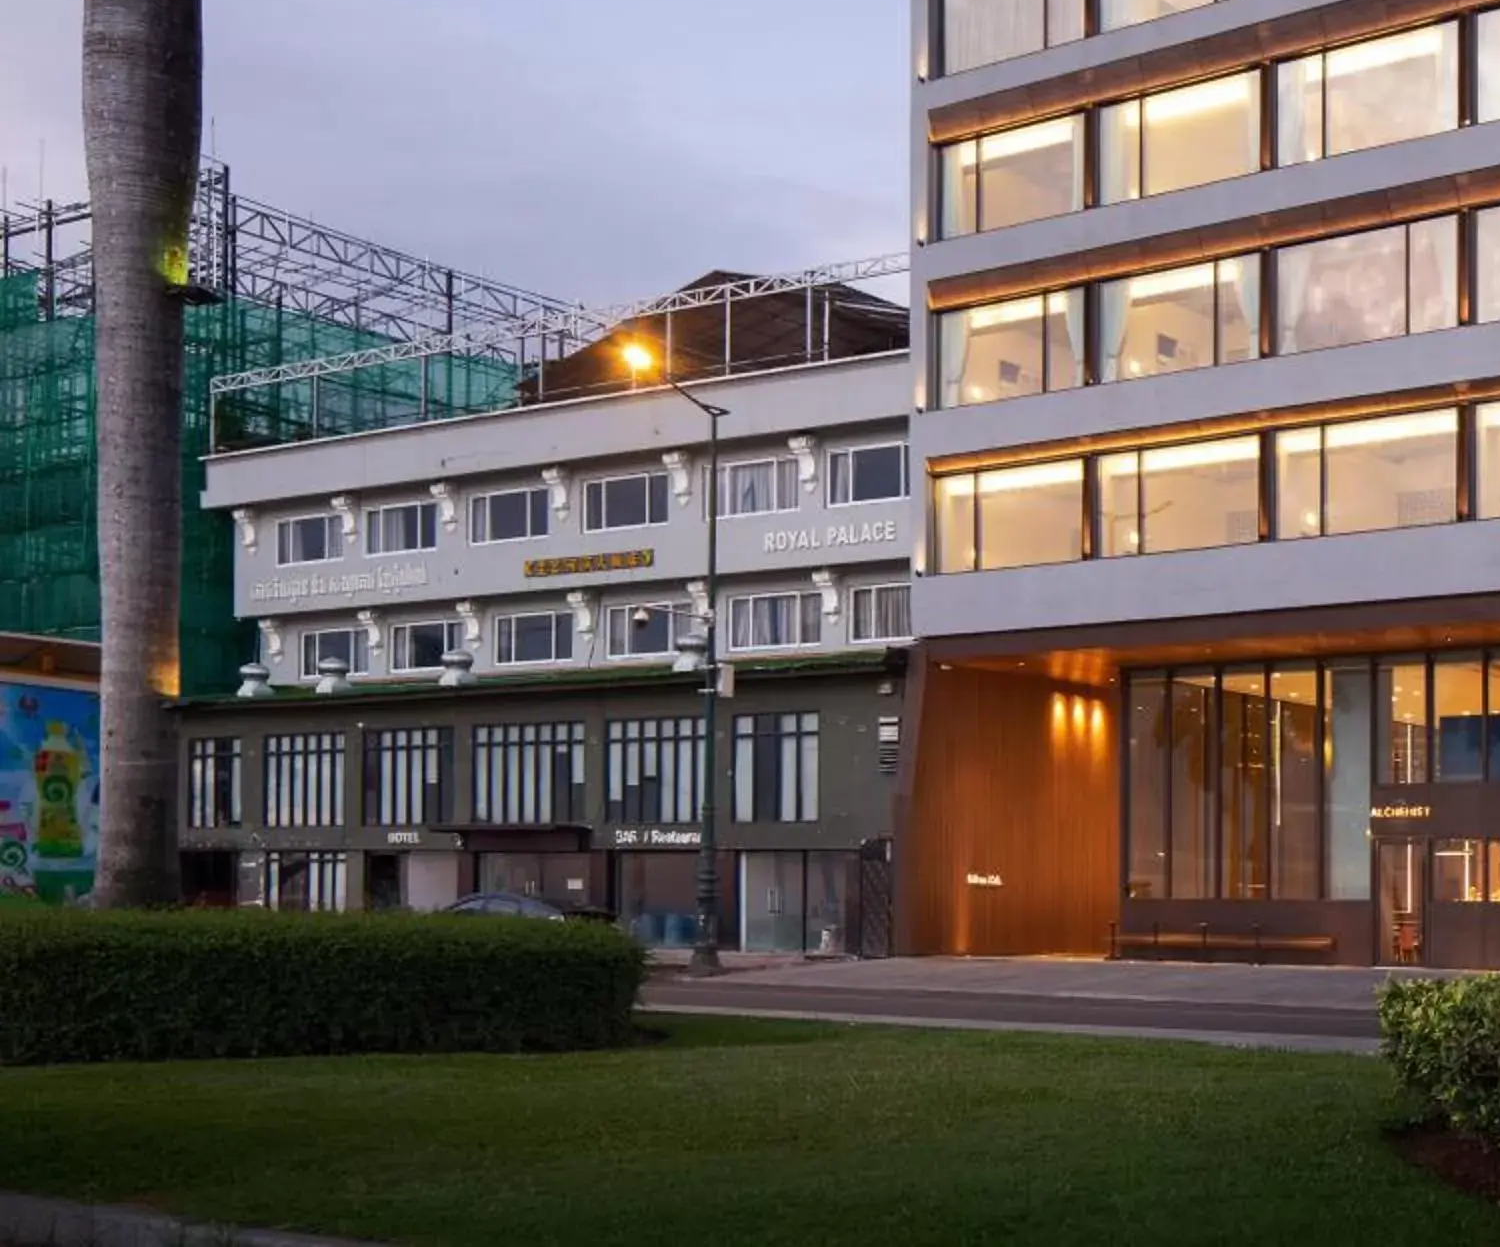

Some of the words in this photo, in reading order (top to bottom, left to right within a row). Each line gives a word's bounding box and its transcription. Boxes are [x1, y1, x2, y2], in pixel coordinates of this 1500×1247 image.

[763, 527, 821, 553] ROYAL
[826, 519, 896, 546] PALACE
[651, 829, 702, 844] Restaura
